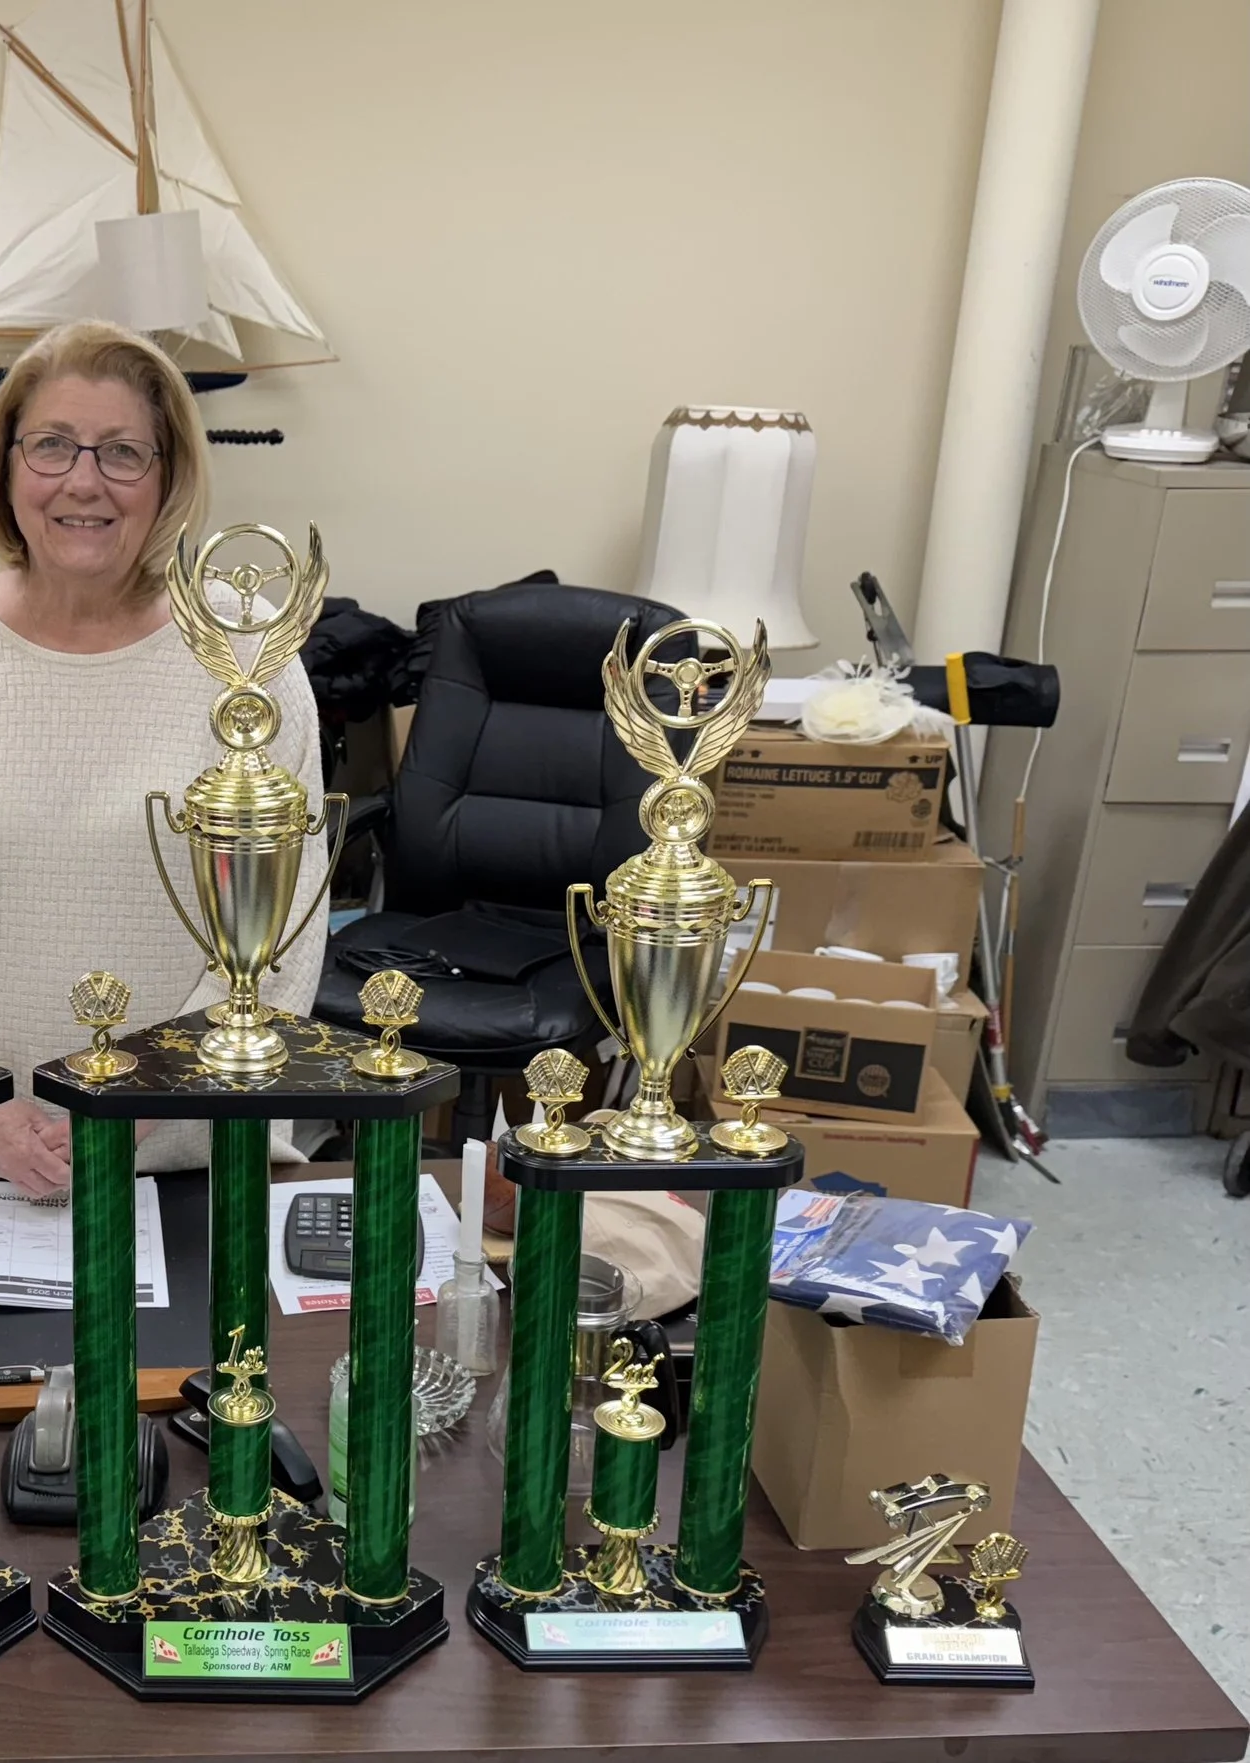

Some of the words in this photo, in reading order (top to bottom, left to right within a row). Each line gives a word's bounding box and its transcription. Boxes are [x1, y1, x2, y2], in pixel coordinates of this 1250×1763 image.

[924, 755, 943, 764] UP
[726, 766, 780, 781] ROMAINE
[781, 769, 832, 783] LETTUCE
[859, 772, 882, 784] CUT
[304, 1298, 339, 1307] Notes
[574, 1617, 650, 1628] Cornhole
[183, 1627, 265, 1641] Cornhole
[273, 1628, 311, 1642] Toss
[184, 1643, 220, 1658] Talladega
[264, 1645, 290, 1660] Spring
[290, 1646, 311, 1657] Race
[906, 1652, 944, 1661] GRAND
[948, 1652, 1008, 1663] CHAMPION
[202, 1661, 251, 1672] Sponsored
[253, 1662, 268, 1672] By:
[270, 1662, 292, 1671] ARM
